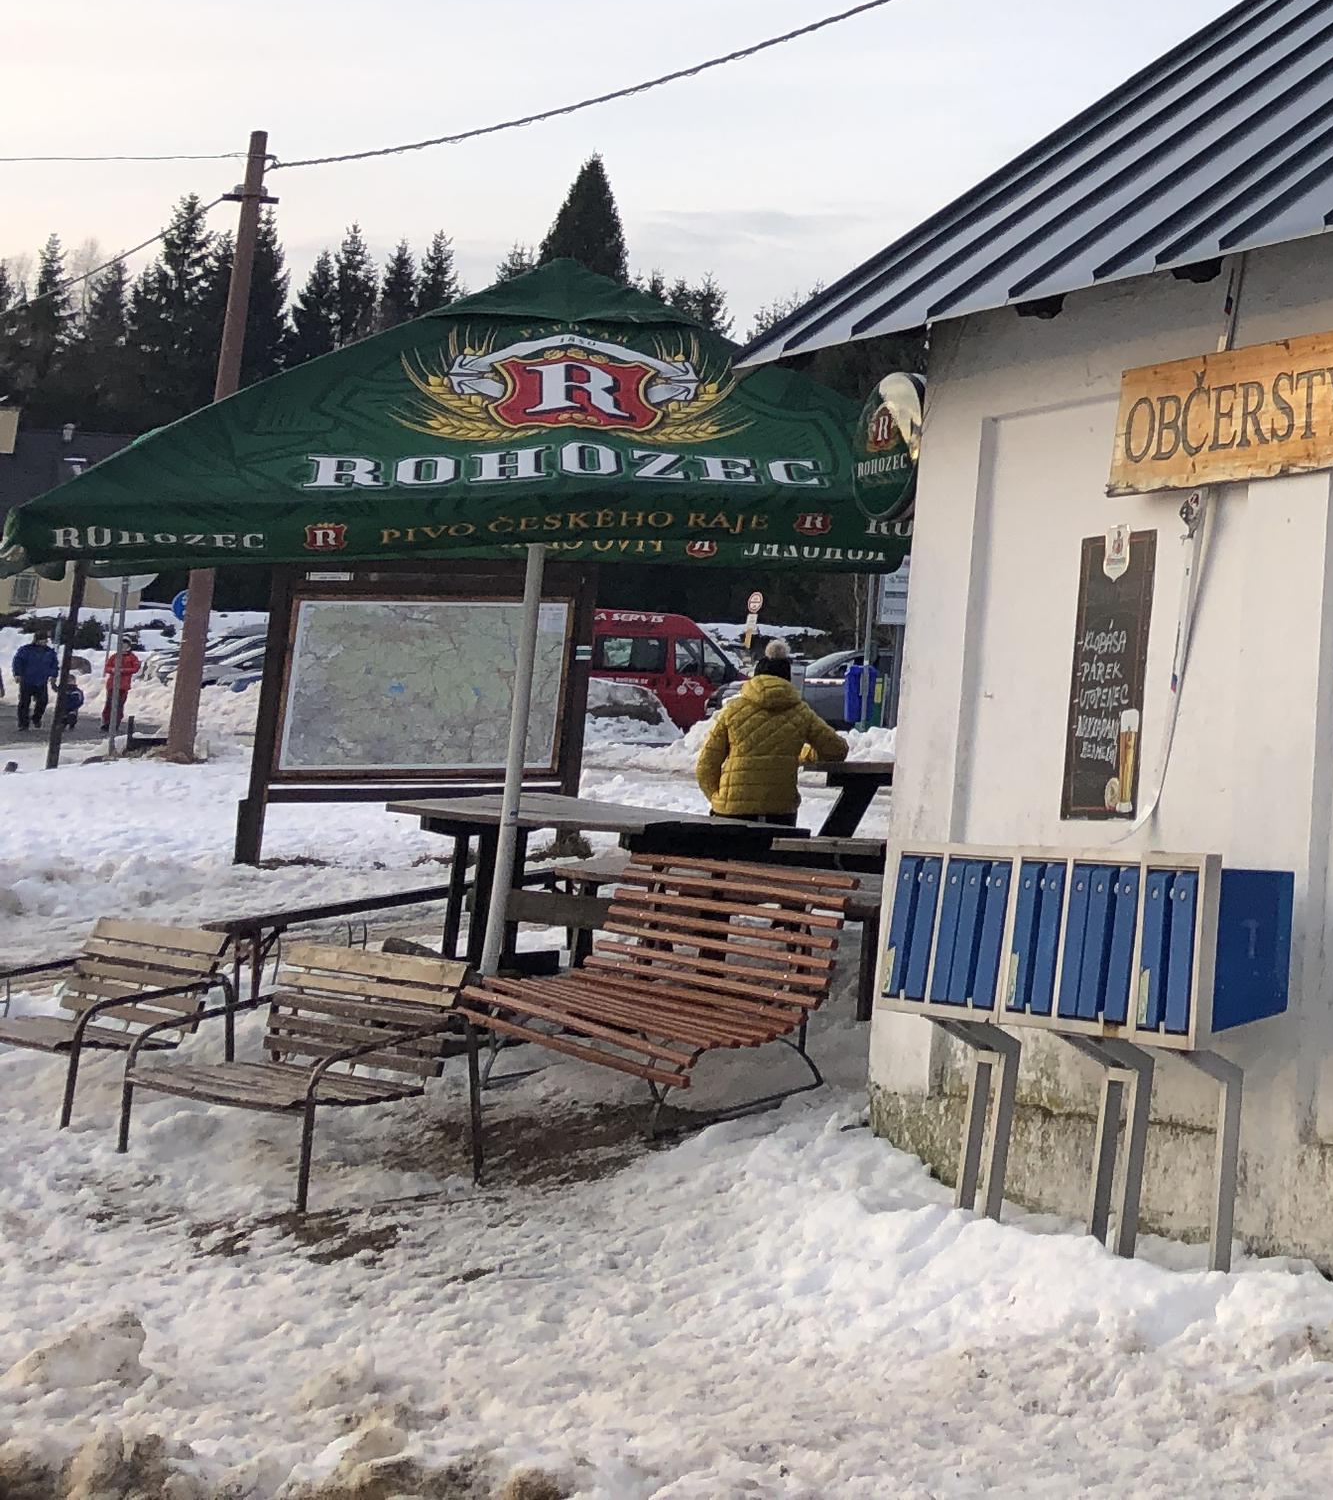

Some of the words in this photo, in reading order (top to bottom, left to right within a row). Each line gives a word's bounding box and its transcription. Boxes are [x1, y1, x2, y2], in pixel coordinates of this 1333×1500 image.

[525, 362, 633, 420] R
[302, 440, 829, 489] ROHOZEC
[857, 453, 908, 478] ROHOZEC
[380, 523, 477, 544] PIVO
